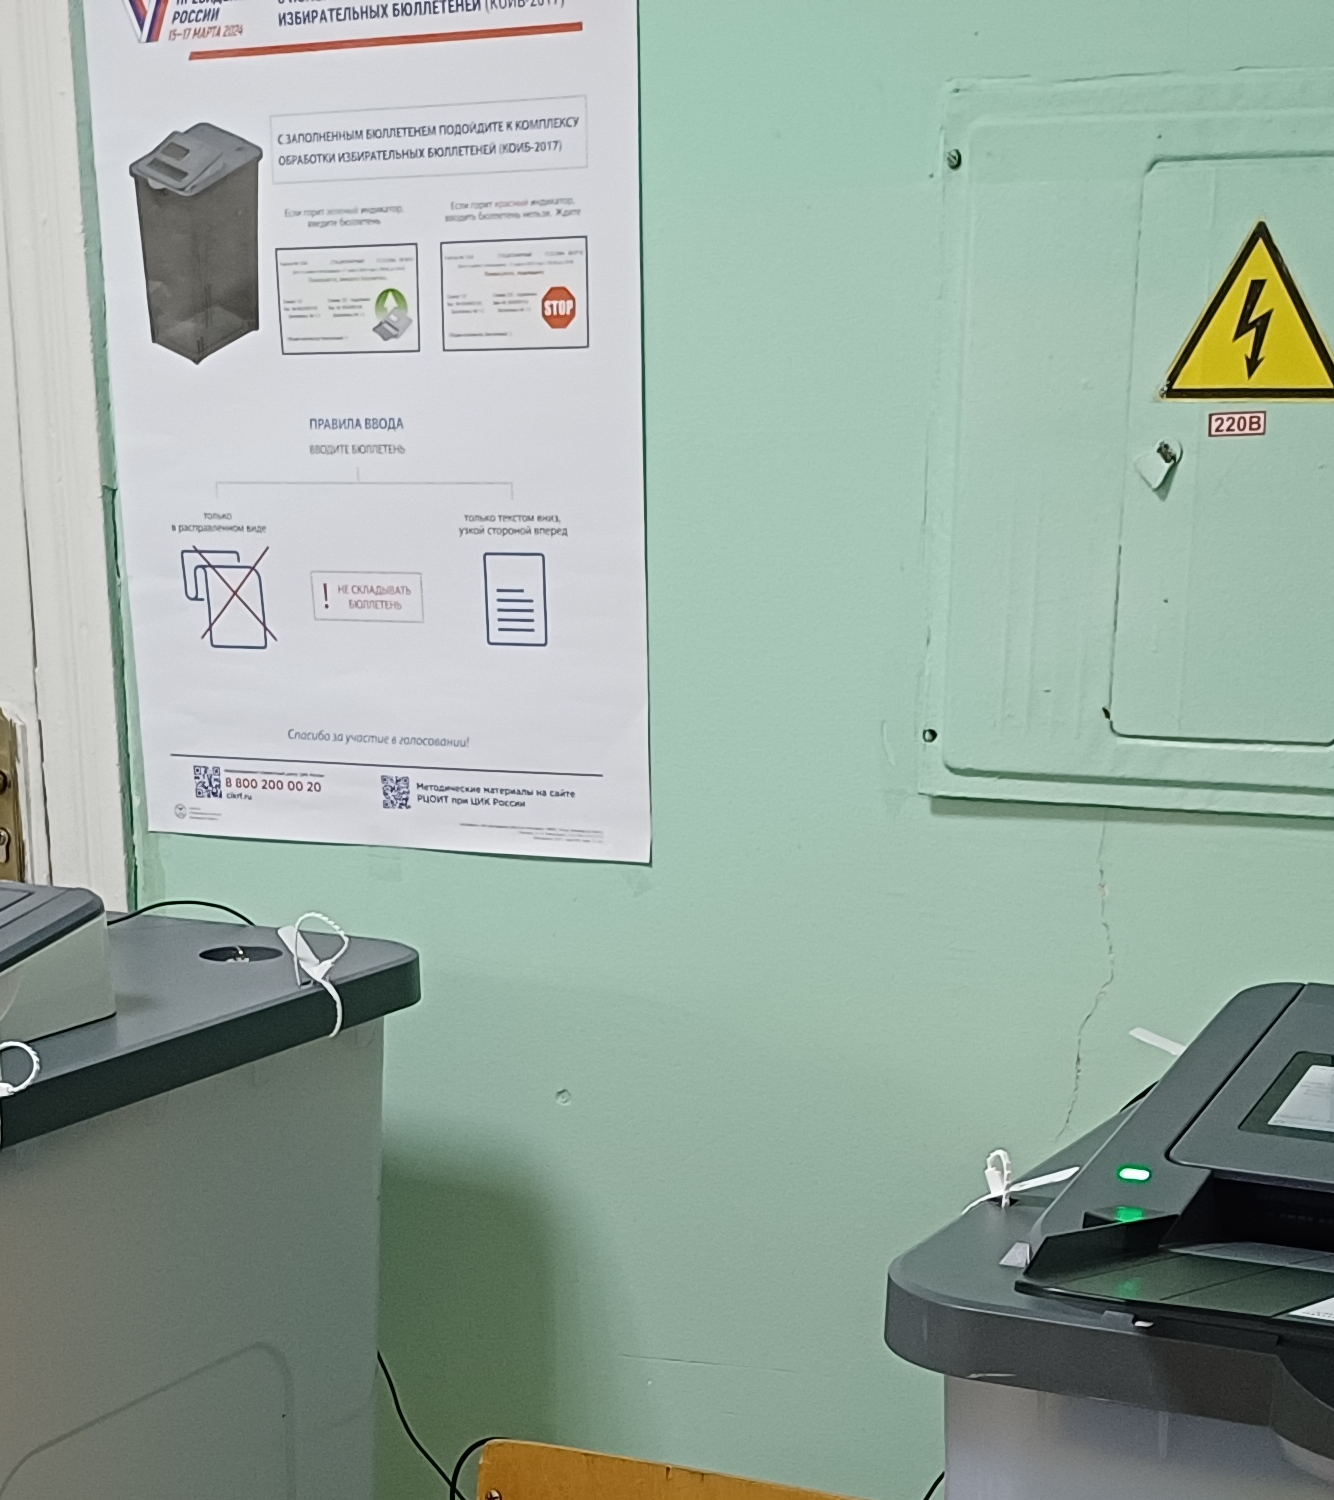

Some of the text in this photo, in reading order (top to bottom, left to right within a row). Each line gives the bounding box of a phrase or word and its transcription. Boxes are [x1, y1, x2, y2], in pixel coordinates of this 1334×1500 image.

[171, 7, 220, 25] РОССИИ
[278, 6, 389, 27] ИЗБИРАТЕЛЬНЫХ
[192, 25, 222, 40] МАРТА
[222, 24, 244, 38] 2024
[277, 117, 579, 145] С ЗАПОЛНЕННЫМ БЮЛЛЕТЕНЕМ ПОДОЙДИТЕ К КОМПЛЕКСУ
[278, 153, 335, 166] ОБРАБОТКИ
[338, 148, 425, 163] ИЗБИРАТЕЛЬНЫХ
[428, 143, 496, 158] БЮЛЛЕТЕНЕЙ
[543, 300, 574, 317] STOP
[309, 417, 404, 431] ПРАВИЛА ВВОДА
[1214, 415, 1262, 433] 220В
[351, 444, 406, 455] БЮЛЛЕТЕНЬ
[487, 525, 532, 537] стороной
[533, 527, 569, 537] вперед
[337, 585, 412, 596] НЕ СКЛАДЫВАТЬ
[348, 599, 402, 610] БЮЛЛЕТЕНЬ
[287, 728, 470, 748] Спасибо за участие в голосовании!
[225, 777, 322, 793] 8 800 200 00 20
[416, 782, 576, 798] Методические материалы на сайте
[417, 794, 526, 808] РЦОИТ при ЦИК России
